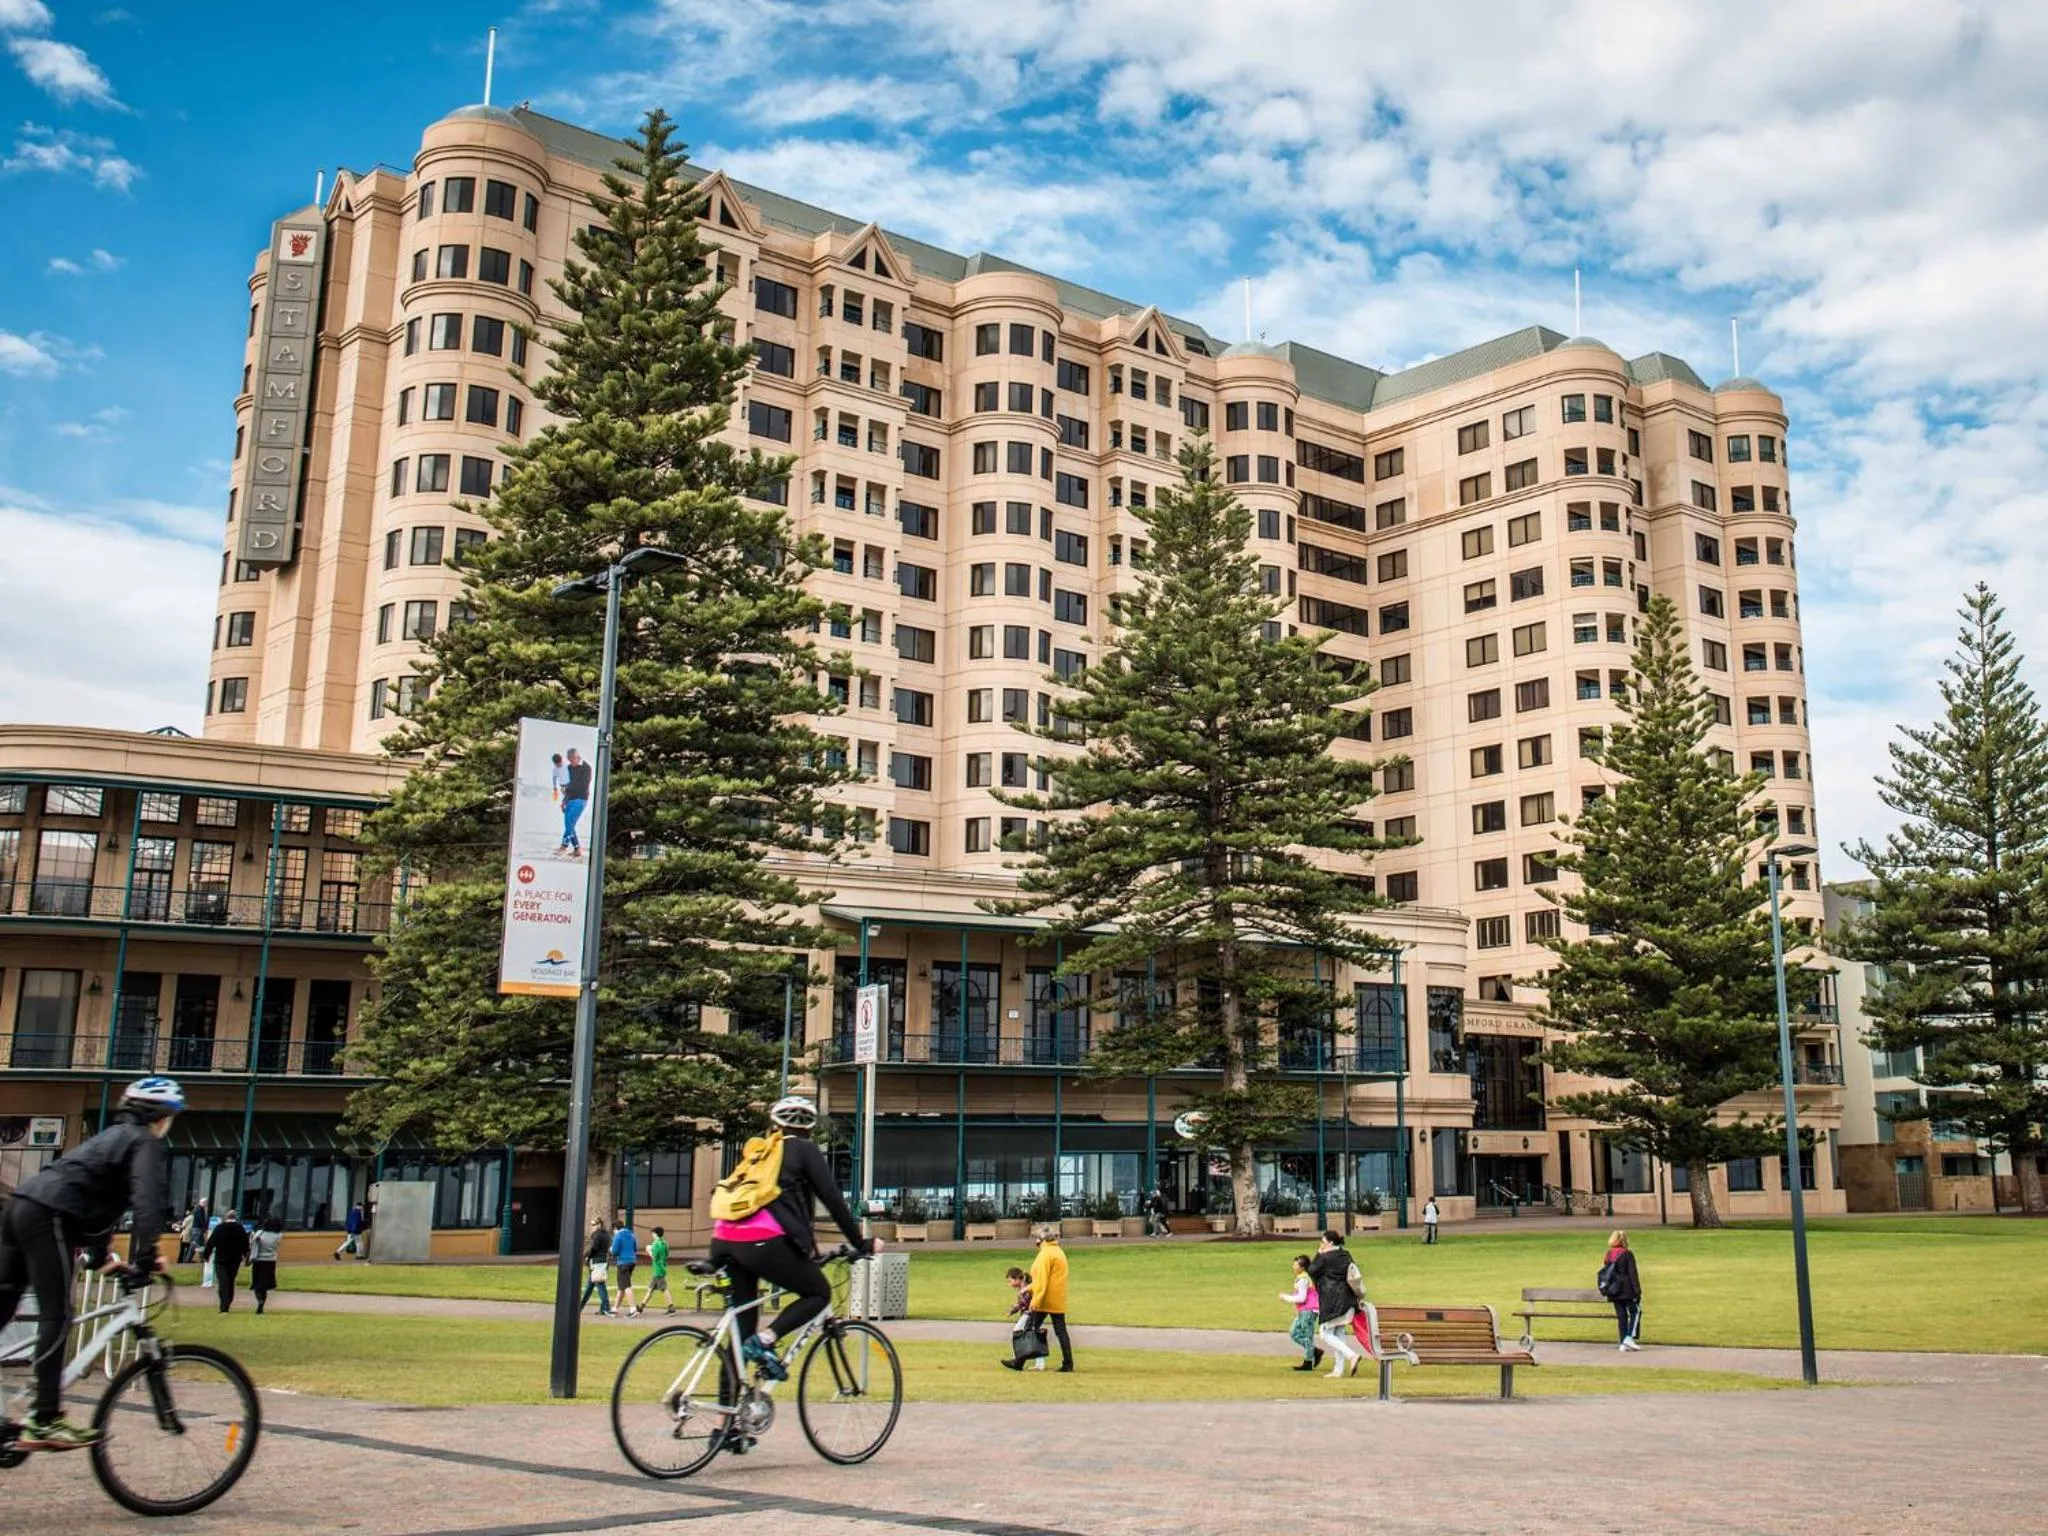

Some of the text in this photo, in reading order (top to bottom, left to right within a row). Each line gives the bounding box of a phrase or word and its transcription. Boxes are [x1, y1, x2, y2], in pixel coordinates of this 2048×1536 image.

[251, 271, 302, 550] STAMFORD
[514, 889, 573, 902] A PLACE FOR
[513, 899, 541, 911] EVERY
[512, 911, 572, 924] GENERATION
